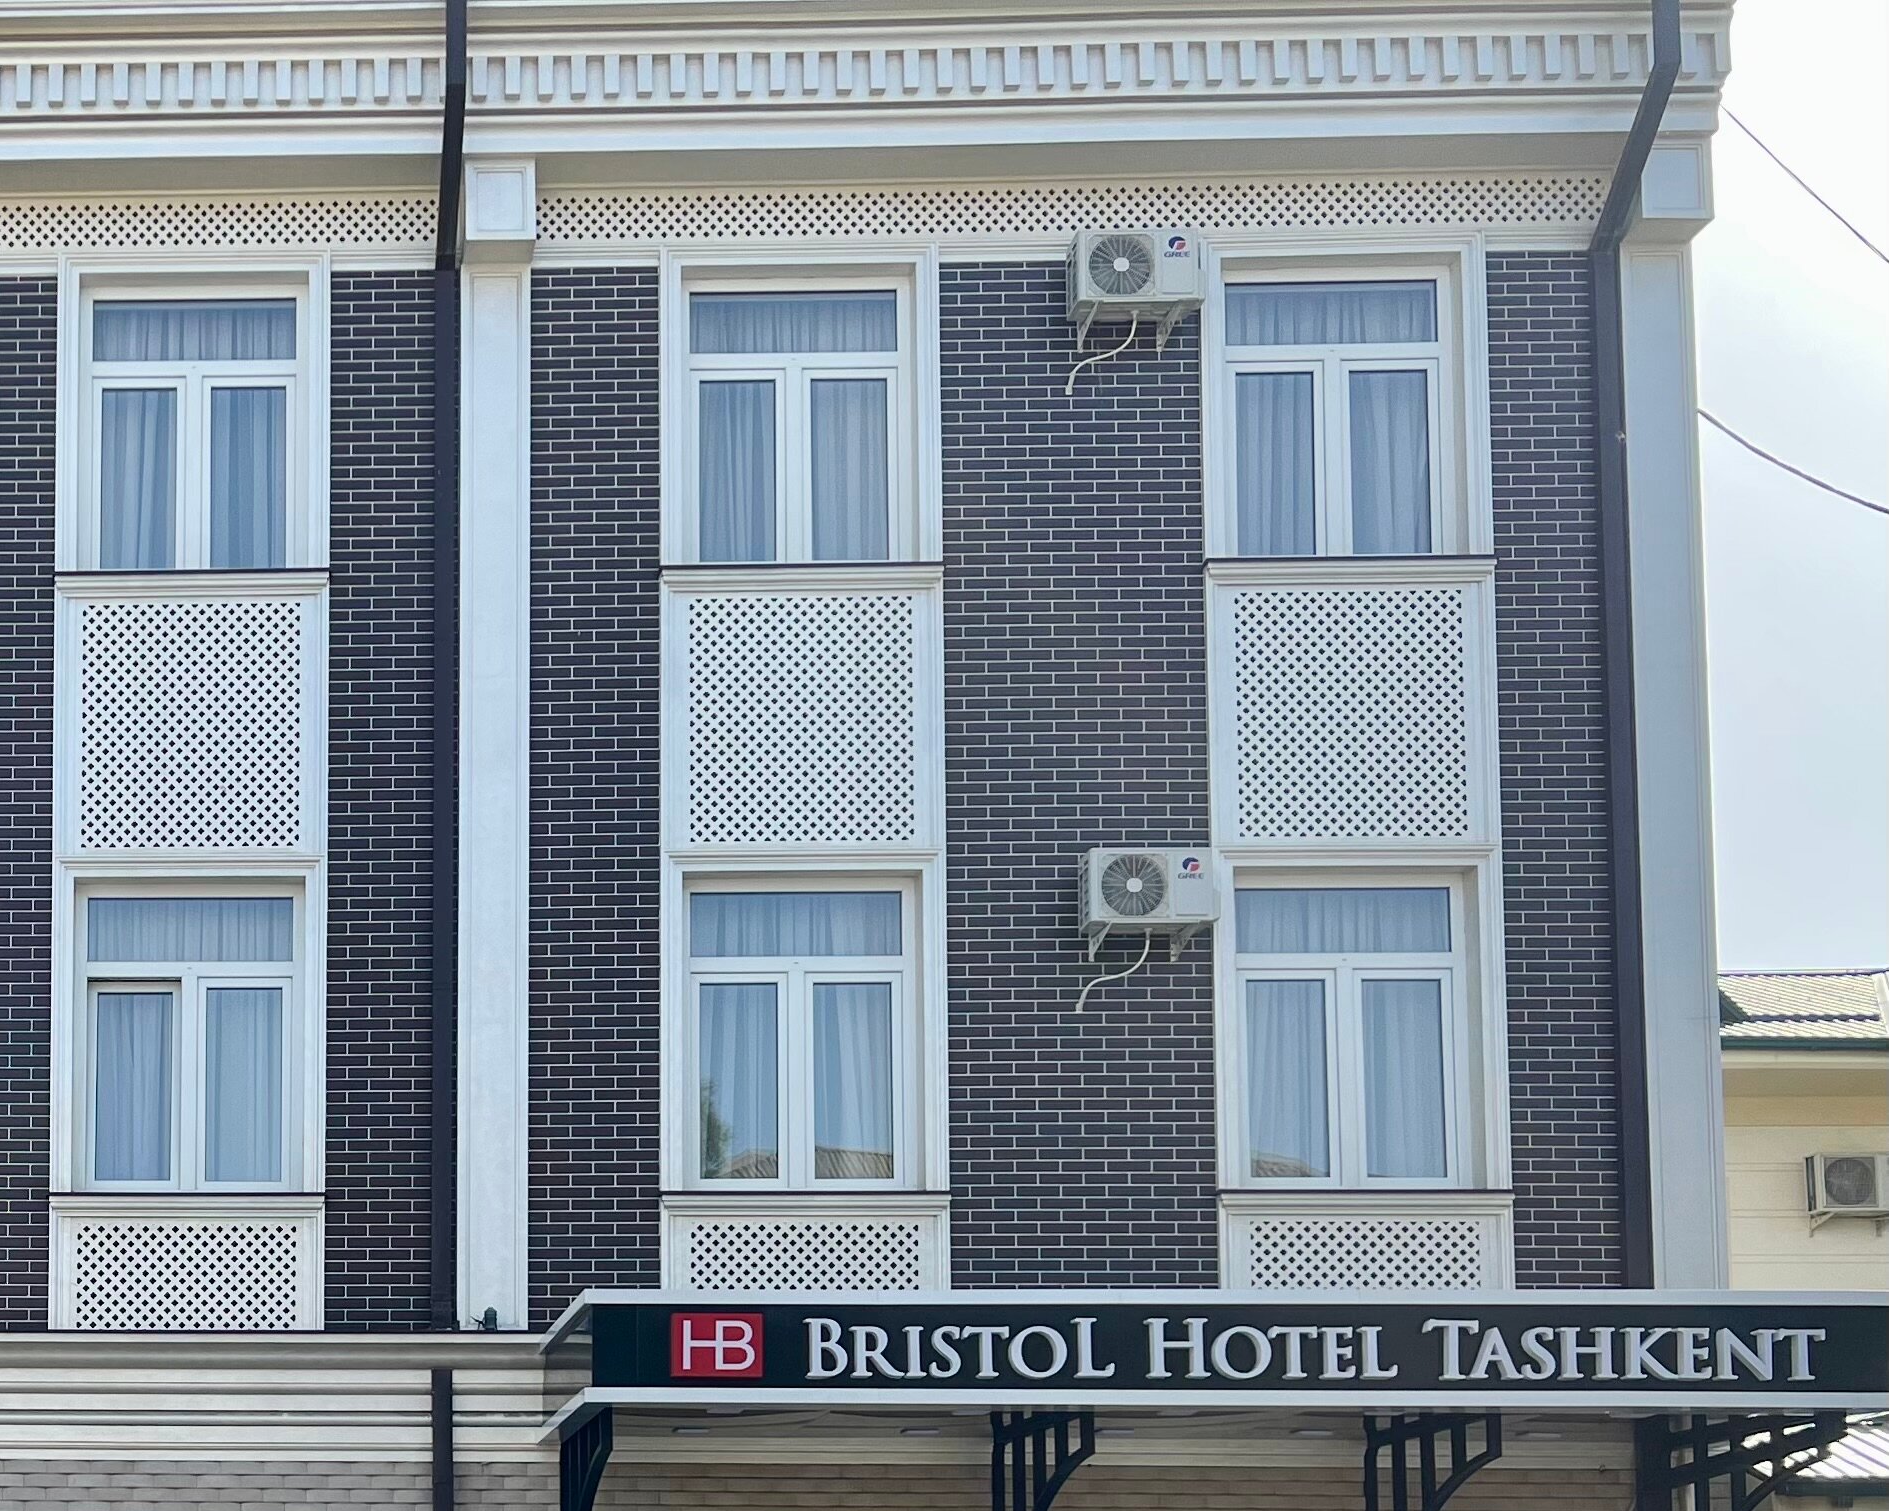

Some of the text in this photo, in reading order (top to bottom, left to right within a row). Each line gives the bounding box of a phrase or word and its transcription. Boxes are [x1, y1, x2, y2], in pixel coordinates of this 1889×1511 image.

[681, 1319, 756, 1372] HB
[802, 1316, 1827, 1382] BRISTOL HOTEL TASHKENT
